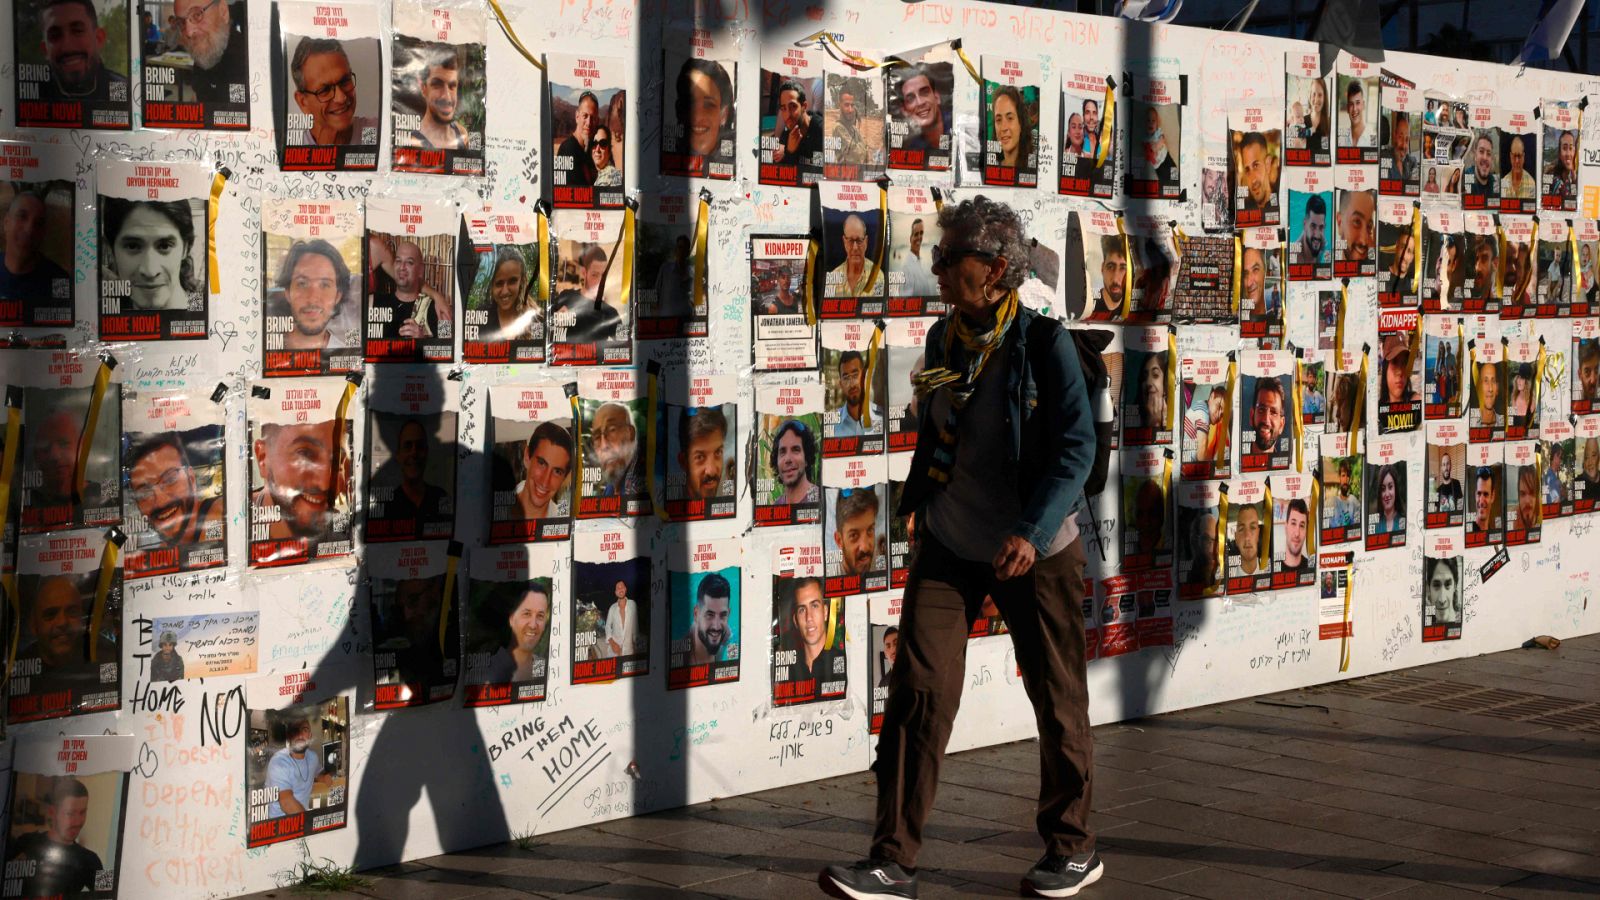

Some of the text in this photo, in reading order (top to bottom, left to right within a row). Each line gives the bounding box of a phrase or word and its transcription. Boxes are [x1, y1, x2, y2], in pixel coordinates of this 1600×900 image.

[19, 64, 50, 82] BRING
[145, 67, 175, 84] BRING
[19, 82, 39, 100] HIM
[146, 85, 165, 101] HIM
[20, 103, 82, 120] HOME NOW!
[146, 103, 204, 121] HOME NOW!
[288, 114, 314, 129] BRING
[395, 115, 421, 130] BRING
[287, 130, 304, 145] HIM
[761, 136, 780, 150] BRING
[285, 146, 336, 164] HOME NOW!
[423, 150, 445, 166] NOW!
[761, 150, 773, 163] HIM
[554, 156, 574, 171] BRING
[554, 170, 567, 185] HIM
[761, 165, 797, 180] HOME NOW!
[147, 178, 179, 187] HERNANDEZ
[554, 187, 594, 202] HOME NOW!
[765, 242, 803, 256] KIDNAPPED
[889, 271, 906, 284] BRING
[101, 280, 131, 297] BRING
[102, 296, 120, 314] HIM
[368, 307, 393, 322] BRING
[465, 310, 488, 325] BRING
[554, 312, 576, 327] BRING
[760, 317, 786, 327] JONATHAN
[1380, 313, 1417, 330] KIDNAPPE
[102, 314, 161, 333] HOME NOW!
[266, 316, 293, 332] BRING
[368, 323, 383, 338] HIM
[465, 326, 479, 340] HER
[554, 327, 567, 342] HIM
[266, 334, 284, 350] HIM
[367, 339, 415, 356] HOME NOW!
[464, 340, 509, 357] HOME NOW!
[266, 349, 320, 368] HOME NOW!
[63, 364, 83, 374] WEISS
[282, 400, 321, 411] ELIA TOLEDANO
[889, 406, 906, 419] BRING
[296, 412, 307, 422] (27)
[824, 412, 840, 425] BRING
[1387, 414, 1414, 430] NOW!!
[824, 423, 835, 437] HIM
[889, 419, 900, 432] HIM
[581, 467, 601, 483] BRING
[756, 479, 775, 492] BRING
[579, 495, 620, 512] HOME NOW!
[756, 491, 768, 505] HIM
[755, 505, 791, 520] HOME NOW!
[252, 523, 270, 540] HIM
[150, 547, 179, 566] NOW!
[891, 542, 908, 555] BRING
[892, 555, 903, 568] HIM
[575, 631, 597, 647] BRING
[575, 647, 589, 661] HIM
[775, 650, 797, 666] BRING
[574, 659, 616, 678] HOME NOW!
[690, 664, 708, 680] NOW!
[775, 665, 789, 682] HIM
[10, 677, 30, 696] HIM
[774, 678, 815, 697] HOME NOW!
[129, 681, 185, 714] HOME
[825, 719, 833, 735] 9
[488, 716, 546, 762] BRING
[521, 715, 575, 761] THEM
[58, 751, 87, 761] ITAY CHEN
[542, 717, 602, 784] HOME
[142, 773, 233, 821] Depend
[251, 787, 279, 805] BRING
[251, 804, 269, 822] HIM
[250, 813, 305, 840] HOME NOW!
[5, 861, 36, 878] BRING
[144, 847, 245, 887] context
[4, 879, 23, 897] HIM
